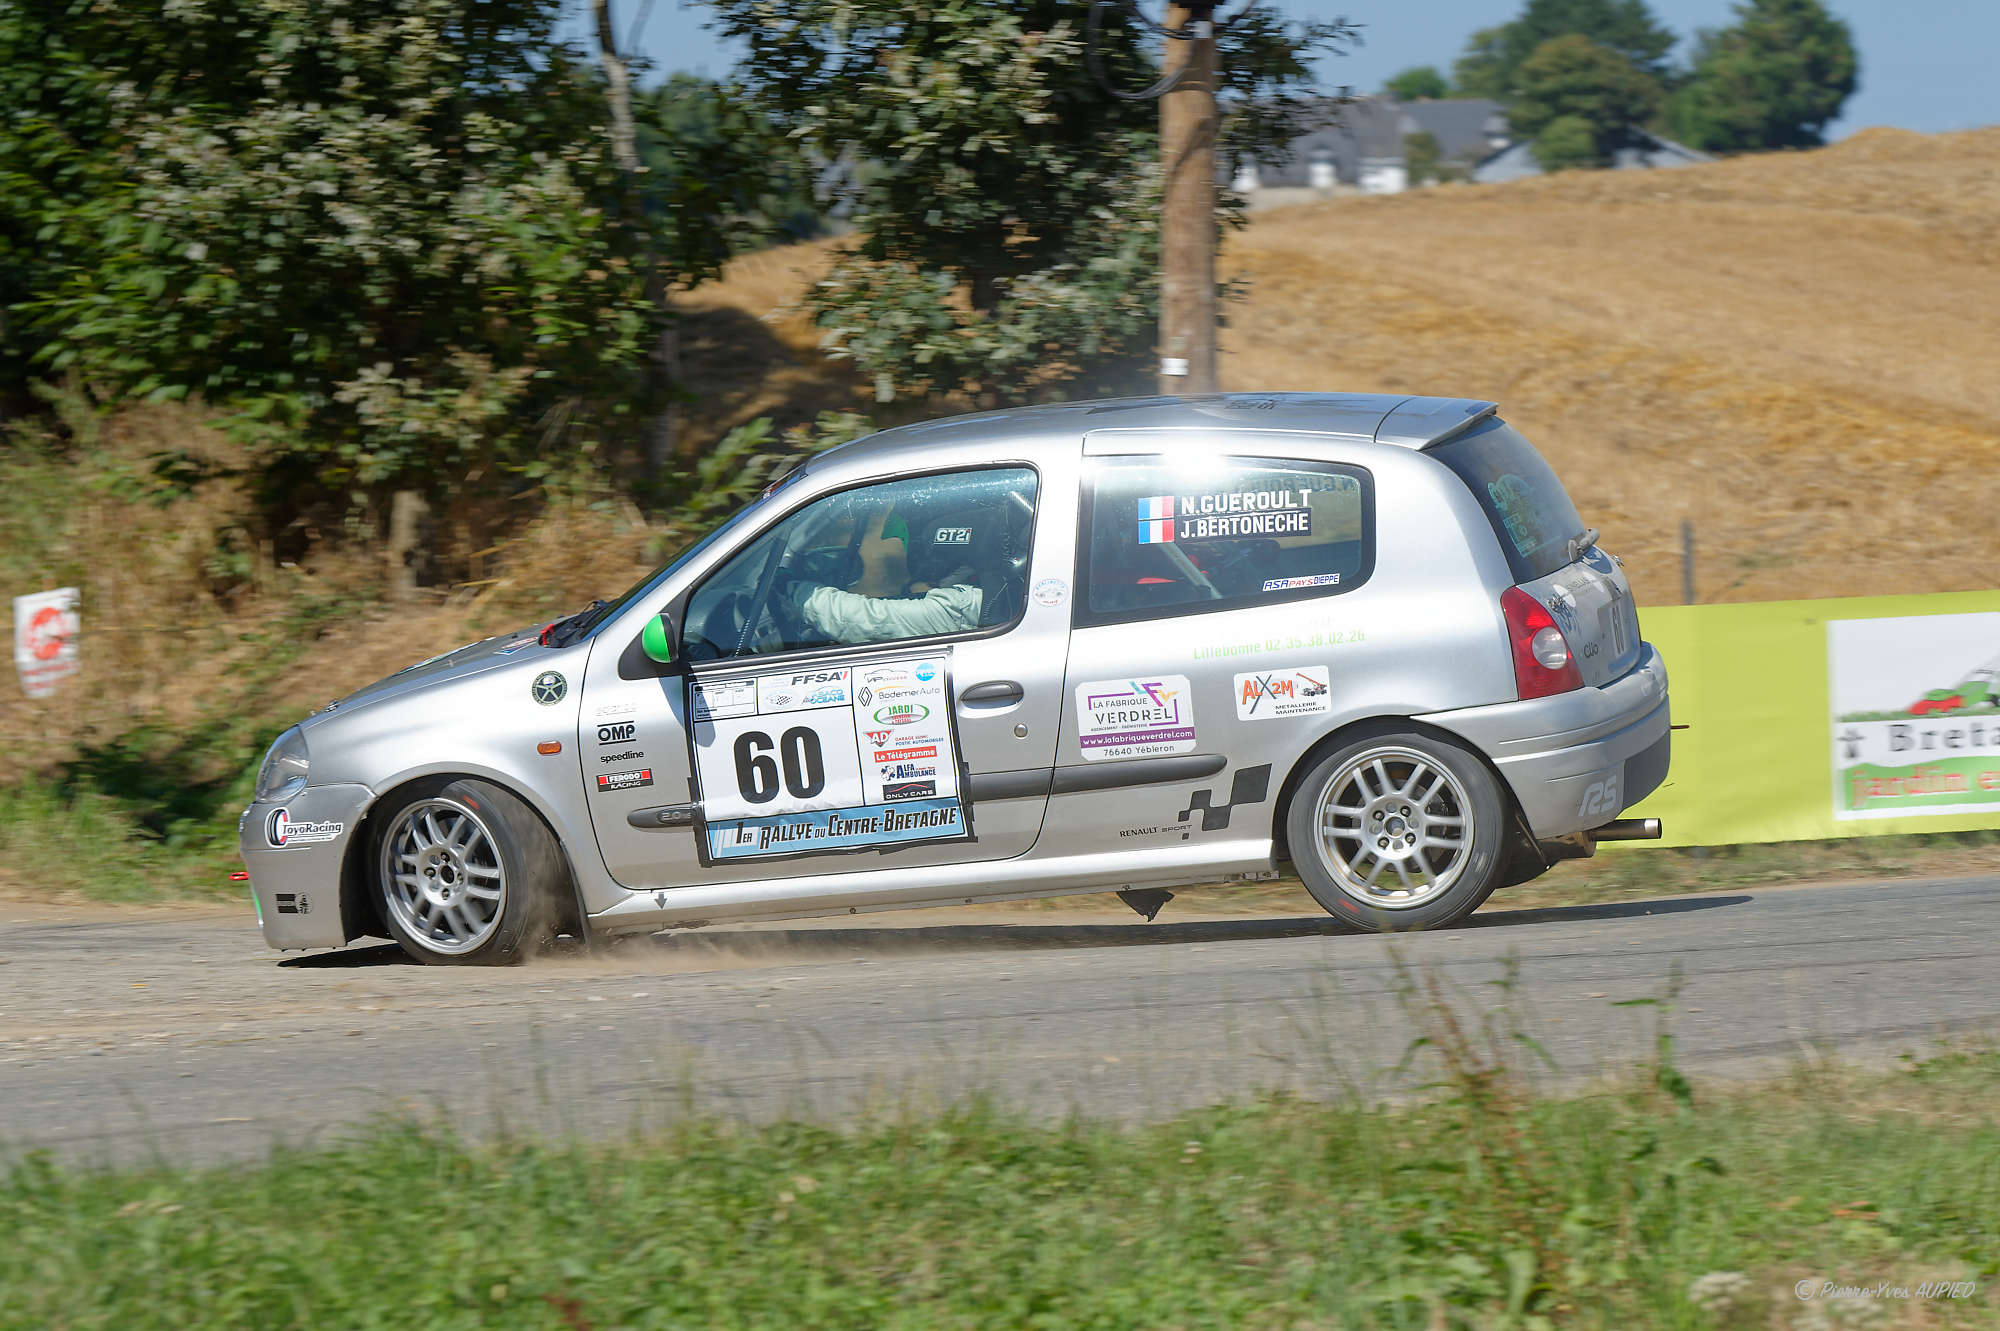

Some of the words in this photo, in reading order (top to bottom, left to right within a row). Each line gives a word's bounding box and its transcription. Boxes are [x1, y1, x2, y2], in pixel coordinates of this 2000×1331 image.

[1181, 488, 1312, 515] N.GUEROULT
[1180, 513, 1309, 539] J.BERTONECHE
[936, 529, 971, 542] GT2i
[1583, 640, 1599, 659] Clio
[791, 672, 841, 686] FFSA
[888, 704, 913, 715] JARDI
[1093, 701, 1104, 709] LA
[1105, 697, 1148, 708] FABRIQUE
[1095, 708, 1173, 725] VERDREL
[1275, 706, 1327, 715] MAINTENANCE
[597, 724, 636, 742] OMP
[871, 731, 888, 742] AD
[1082, 730, 1193, 745] www.lafabriqueverdrel.com
[600, 750, 644, 764] speedline
[875, 753, 885, 761] Le
[886, 749, 935, 760] Télégramme
[1103, 748, 1132, 757] 76640
[1135, 745, 1175, 755] Yébleron
[733, 726, 826, 804] 60
[608, 772, 641, 783] FERODO
[610, 781, 641, 790] RACING
[910, 789, 933, 797] CARS
[282, 822, 342, 836] ToyoRacing
[759, 822, 813, 849] RALLYE
[814, 828, 827, 839] DU
[827, 807, 957, 837] CENTRE-BRETAGNE
[1119, 826, 1159, 837] RENAULT
[1161, 824, 1192, 833] SPORT
